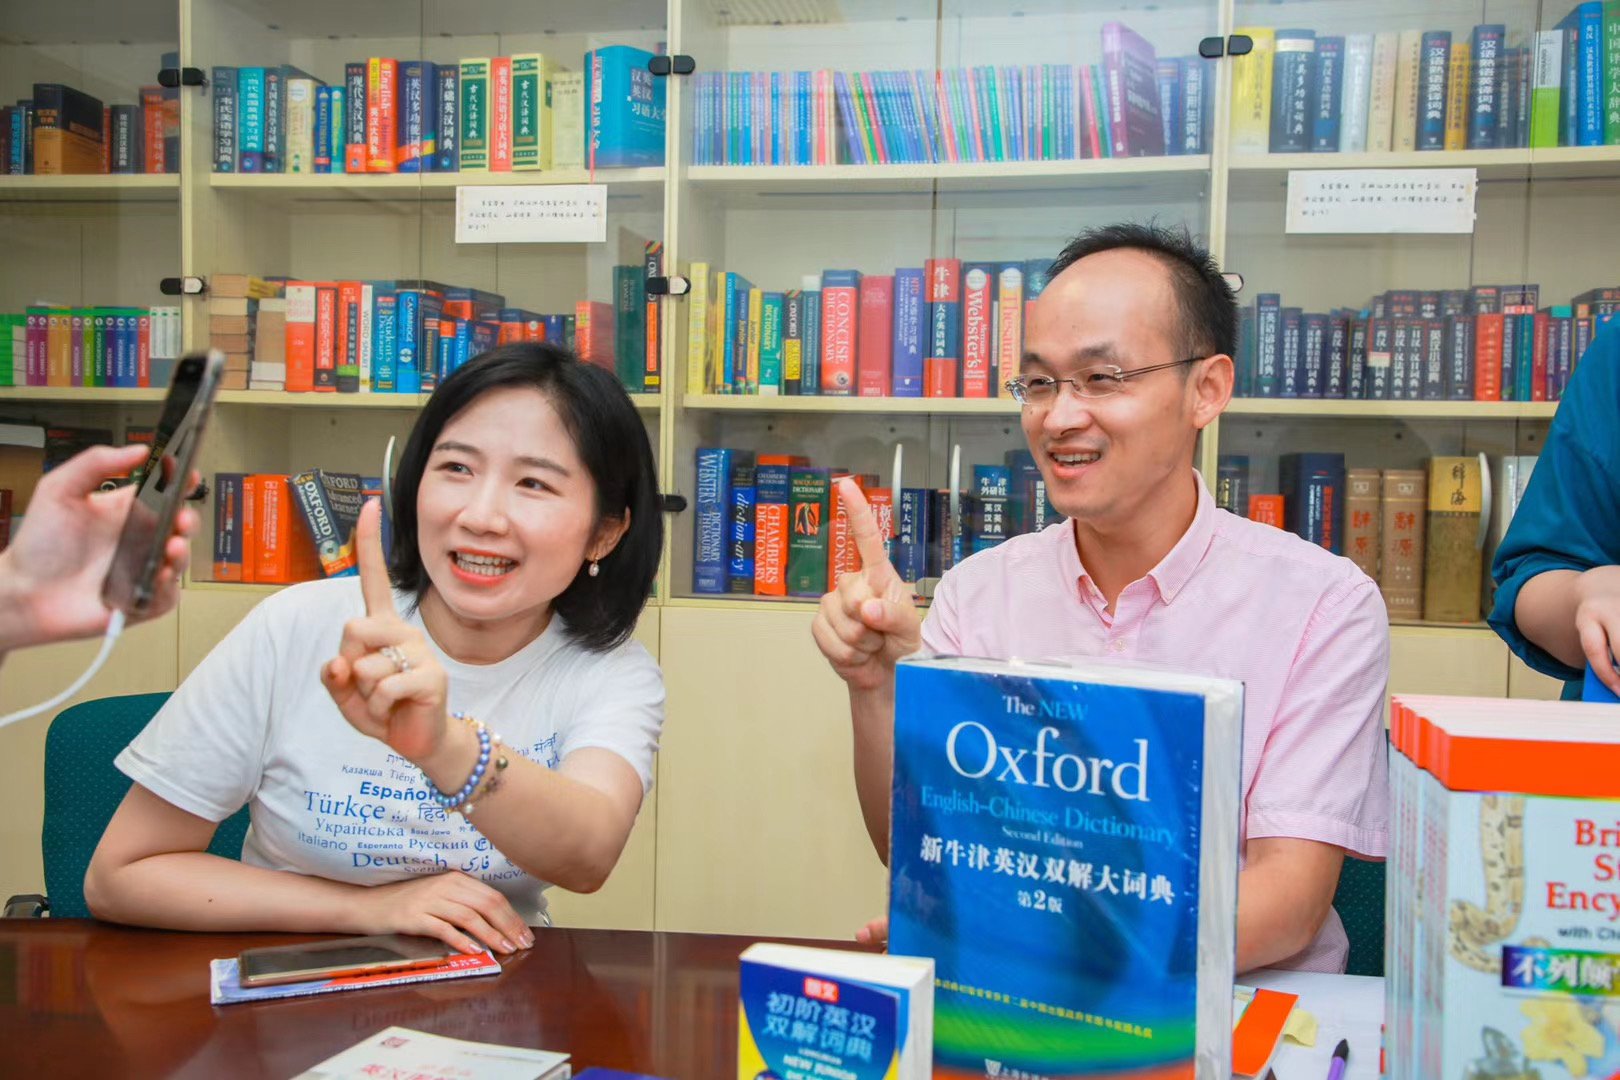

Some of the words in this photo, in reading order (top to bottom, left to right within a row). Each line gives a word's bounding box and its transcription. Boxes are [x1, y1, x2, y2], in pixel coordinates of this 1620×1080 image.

[468, 85, 480, 139] 古代汉语词典
[520, 81, 530, 135] 古代汉语词典
[934, 267, 950, 298] 牛津
[386, 315, 395, 362] Student's
[406, 296, 414, 342] CAMBRIDGE
[826, 293, 836, 362] DICTIONARY
[836, 292, 849, 363] CONCISE
[967, 290, 983, 368] Webster's
[1002, 297, 1018, 379] Thesaurus
[305, 481, 332, 535] OXFORD
[981, 487, 1007, 496] 外研社
[711, 512, 721, 562] DICTIONARY
[901, 492, 912, 544] 英华大词典
[755, 505, 767, 583] DICTIONARY
[766, 505, 780, 583] CHAMBERS
[1003, 695, 1035, 716] The
[1038, 700, 1089, 721] NEW
[342, 765, 383, 777] Қазақша
[946, 720, 1150, 802] Oxford
[304, 790, 386, 824] Türkçe
[315, 818, 405, 837] Українська
[1065, 807, 1177, 849] Dictionary
[352, 852, 448, 869] Deutsch
[358, 842, 404, 850] Esperanto
[409, 839, 469, 852] Русский
[1001, 825, 1041, 843] Second
[1044, 831, 1083, 849] Edition
[920, 835, 1175, 905] 新牛津英汉双解大词典
[1017, 890, 1063, 914] 第2版
[762, 1014, 873, 1063] 双解词典
[766, 992, 876, 1040] 初阶英汉
